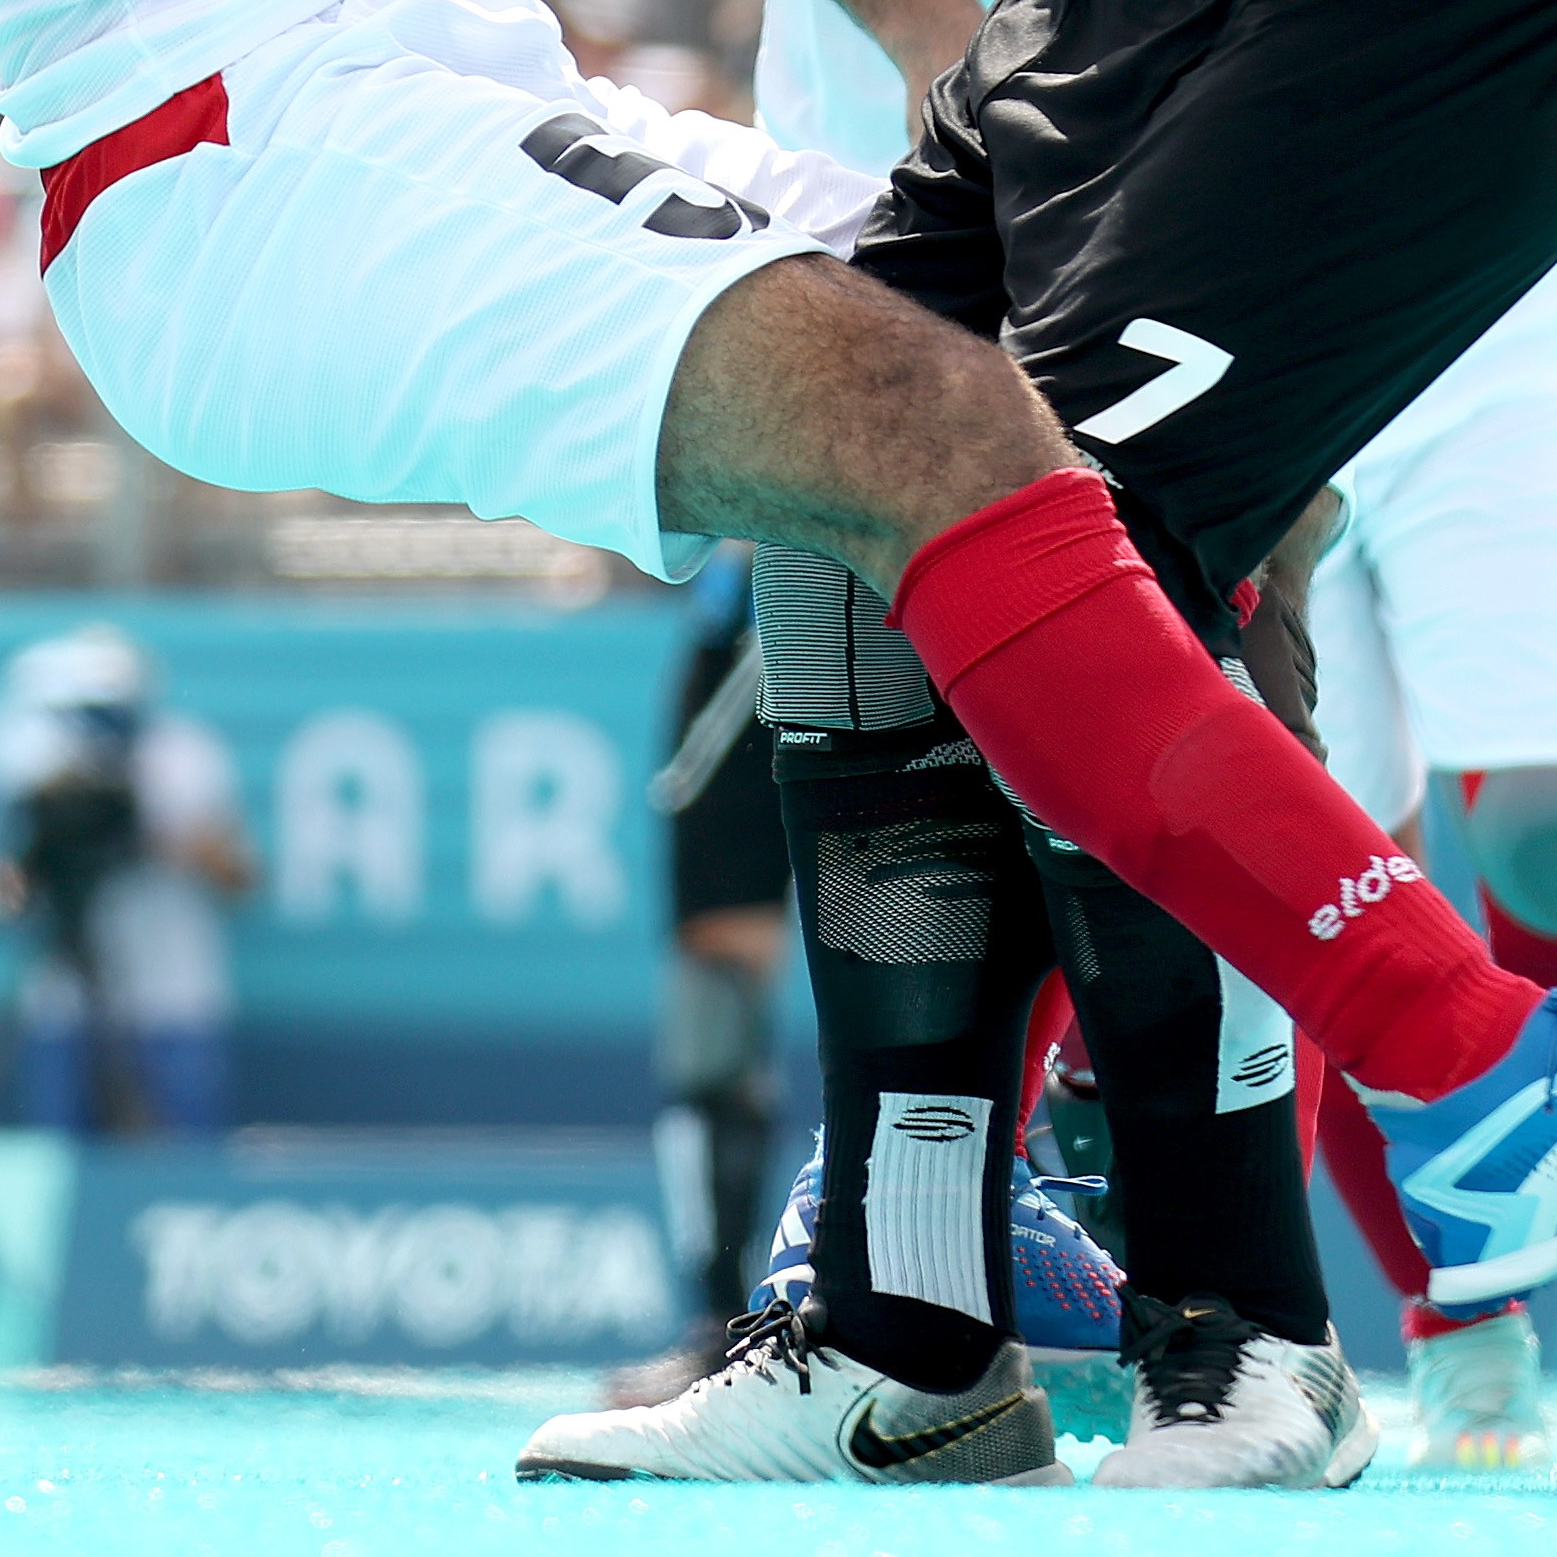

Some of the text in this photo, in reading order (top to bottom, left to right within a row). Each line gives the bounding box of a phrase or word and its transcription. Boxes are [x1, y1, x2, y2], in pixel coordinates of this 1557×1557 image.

[519, 112, 771, 240] 5
[1073, 318, 1235, 445] 7
[779, 731, 828, 745] PROFIT
[132, 1200, 676, 1346] TOYOTA
